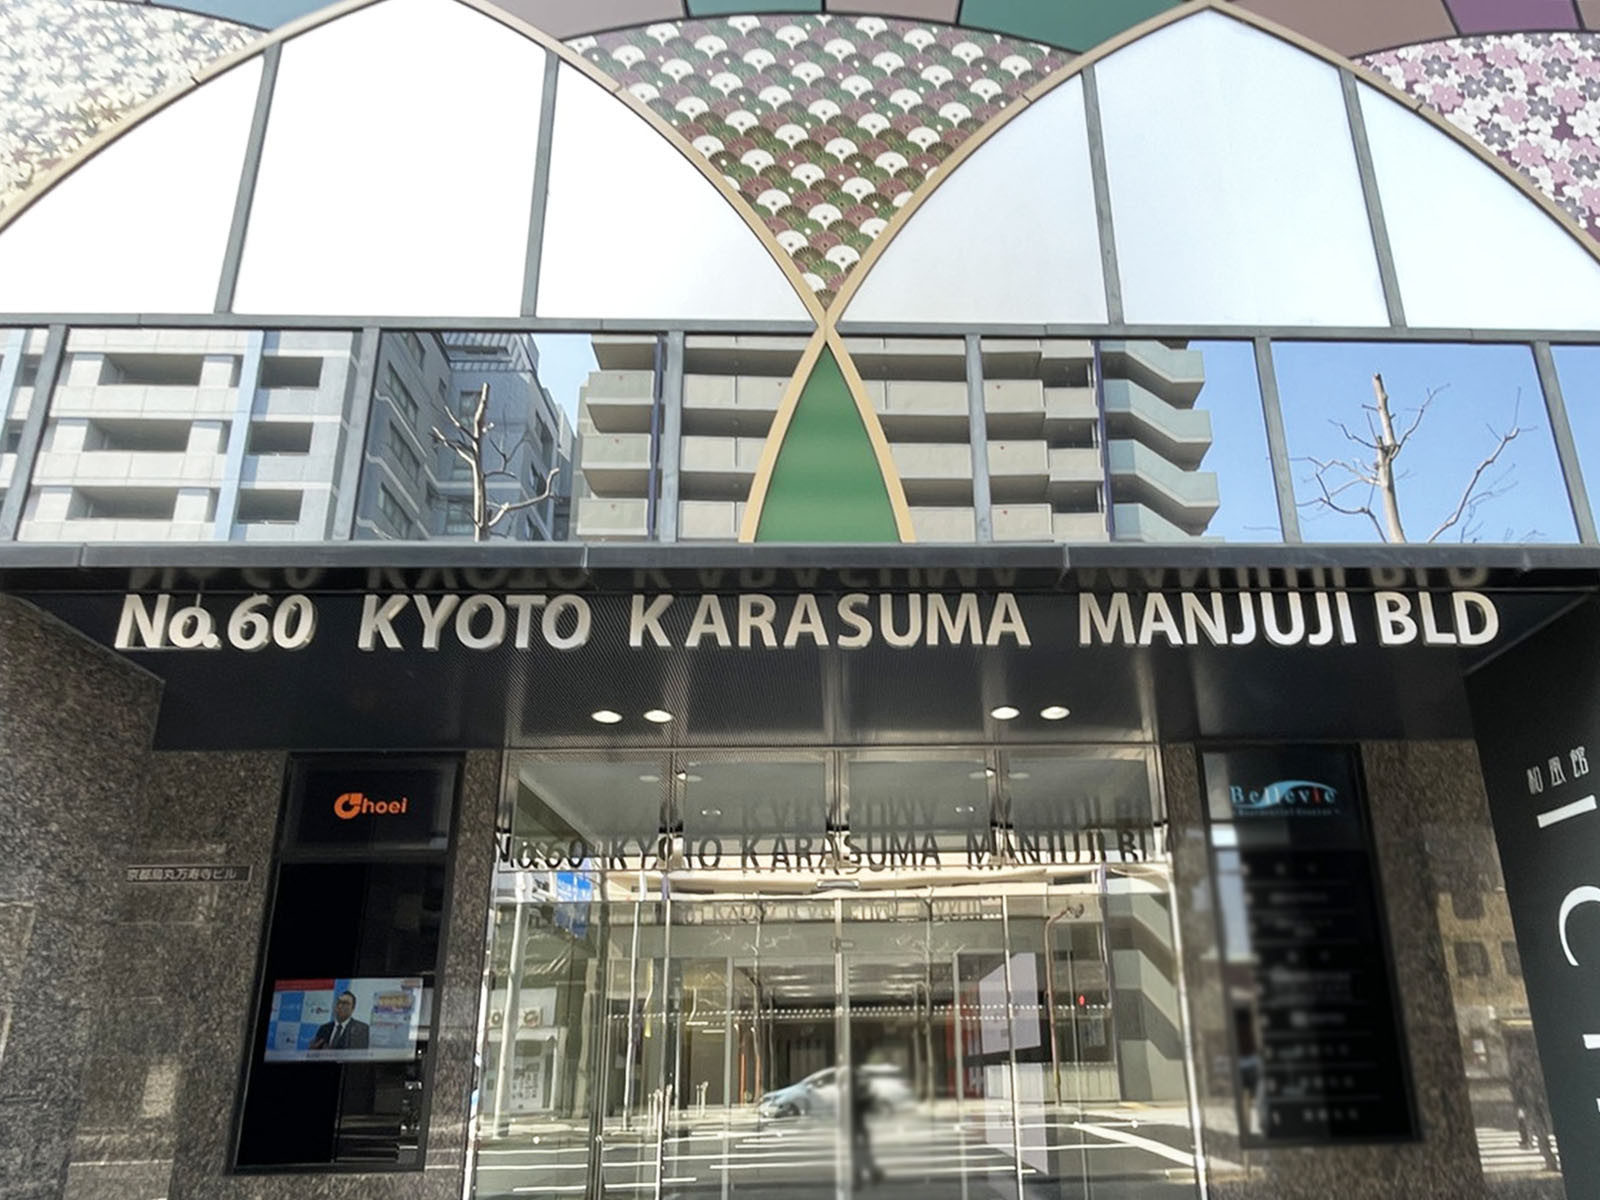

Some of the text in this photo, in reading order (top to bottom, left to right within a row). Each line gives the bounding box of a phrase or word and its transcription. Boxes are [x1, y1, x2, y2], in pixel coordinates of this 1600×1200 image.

[358, 594, 592, 651] KYOTO
[629, 593, 1032, 649] KARASUMA
[1079, 592, 1357, 648] MANJUJI
[1377, 591, 1500, 647] BLD
